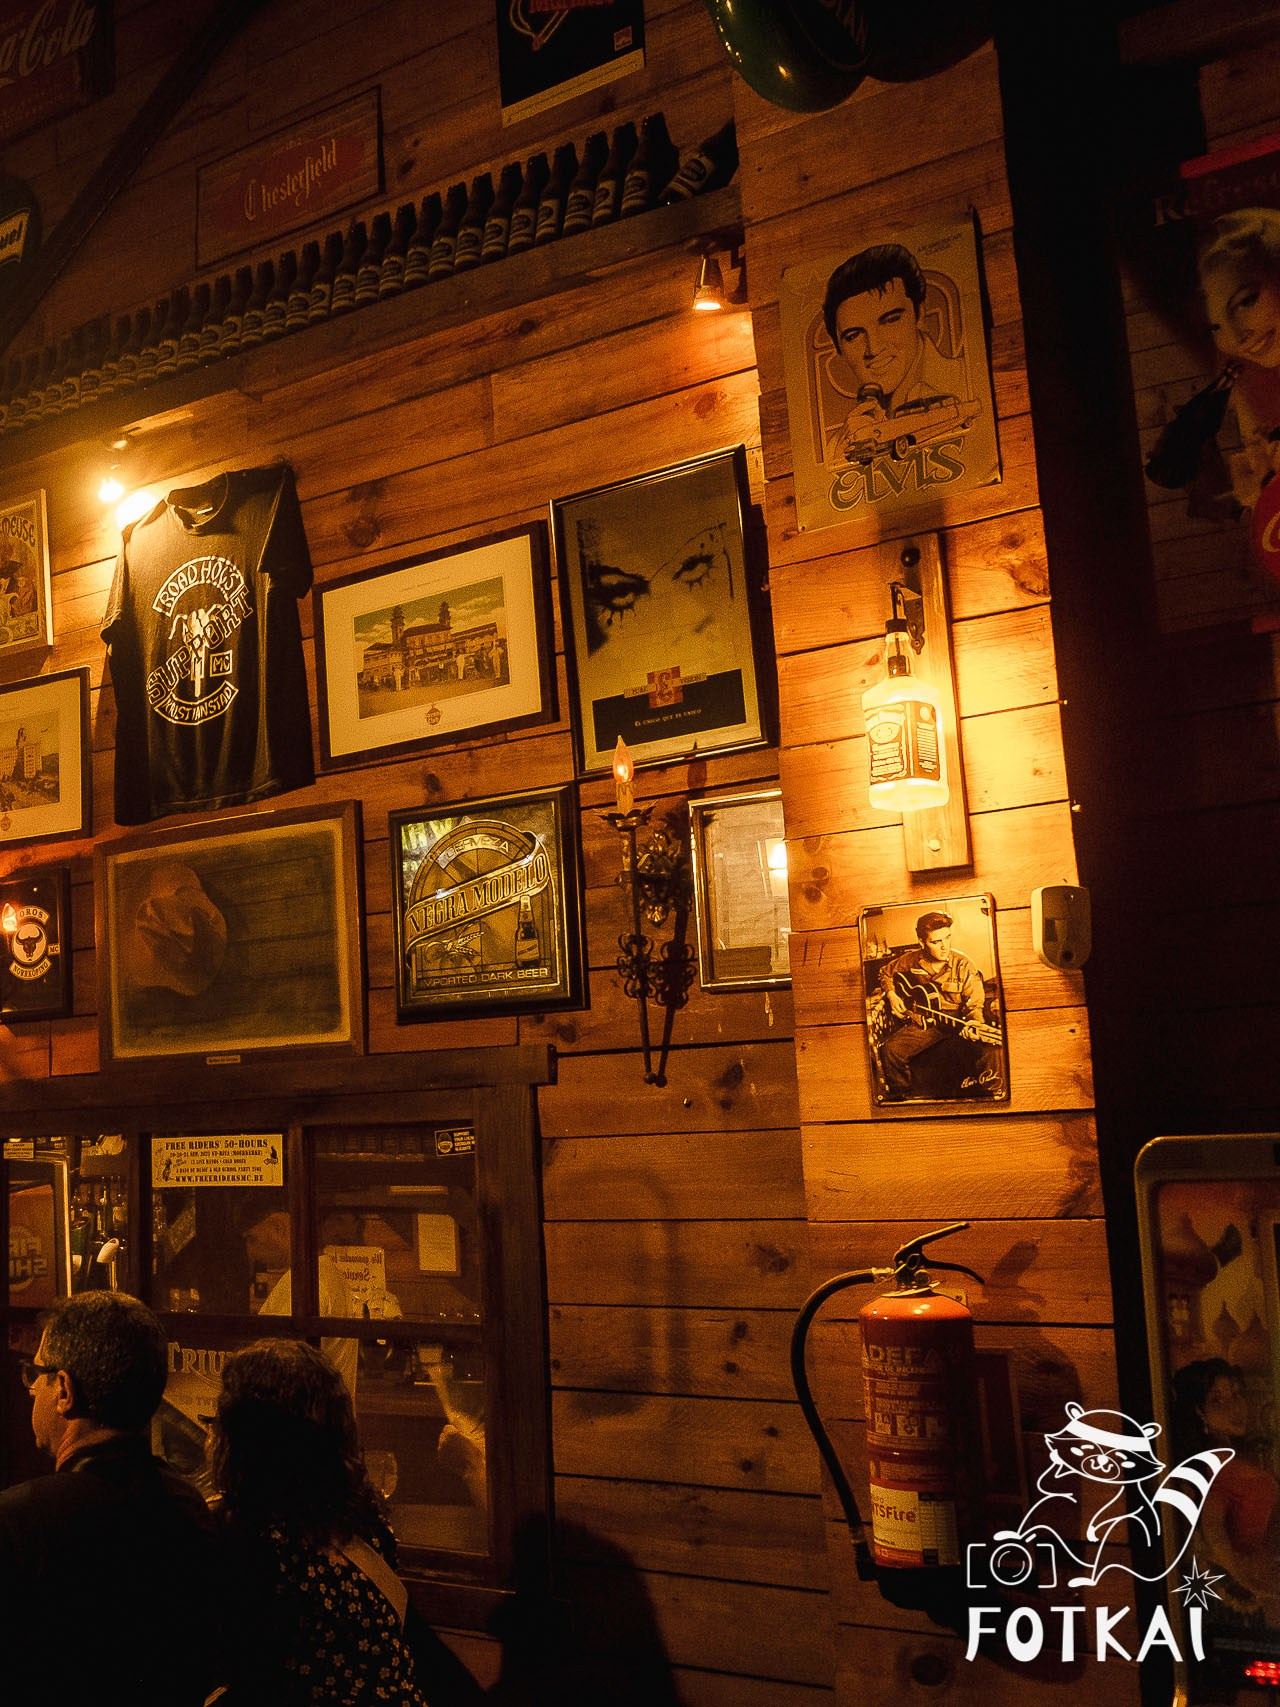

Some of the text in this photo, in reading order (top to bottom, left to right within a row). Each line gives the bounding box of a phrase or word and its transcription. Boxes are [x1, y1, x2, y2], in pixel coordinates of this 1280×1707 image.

[243, 138, 337, 223] Chesterfield
[828, 436, 966, 512] ELVIS
[159, 560, 240, 608] ROAD HOGS
[147, 585, 254, 705] SUPPORT
[212, 656, 231, 673] MC
[408, 852, 548, 934] NEGRA MODELO
[49, 945, 59, 954] MC
[482, 971, 512, 982] DARK
[517, 967, 549, 979] BEER
[166, 1141, 186, 1150] FREE
[224, 1139, 269, 1149] 50-HOURS
